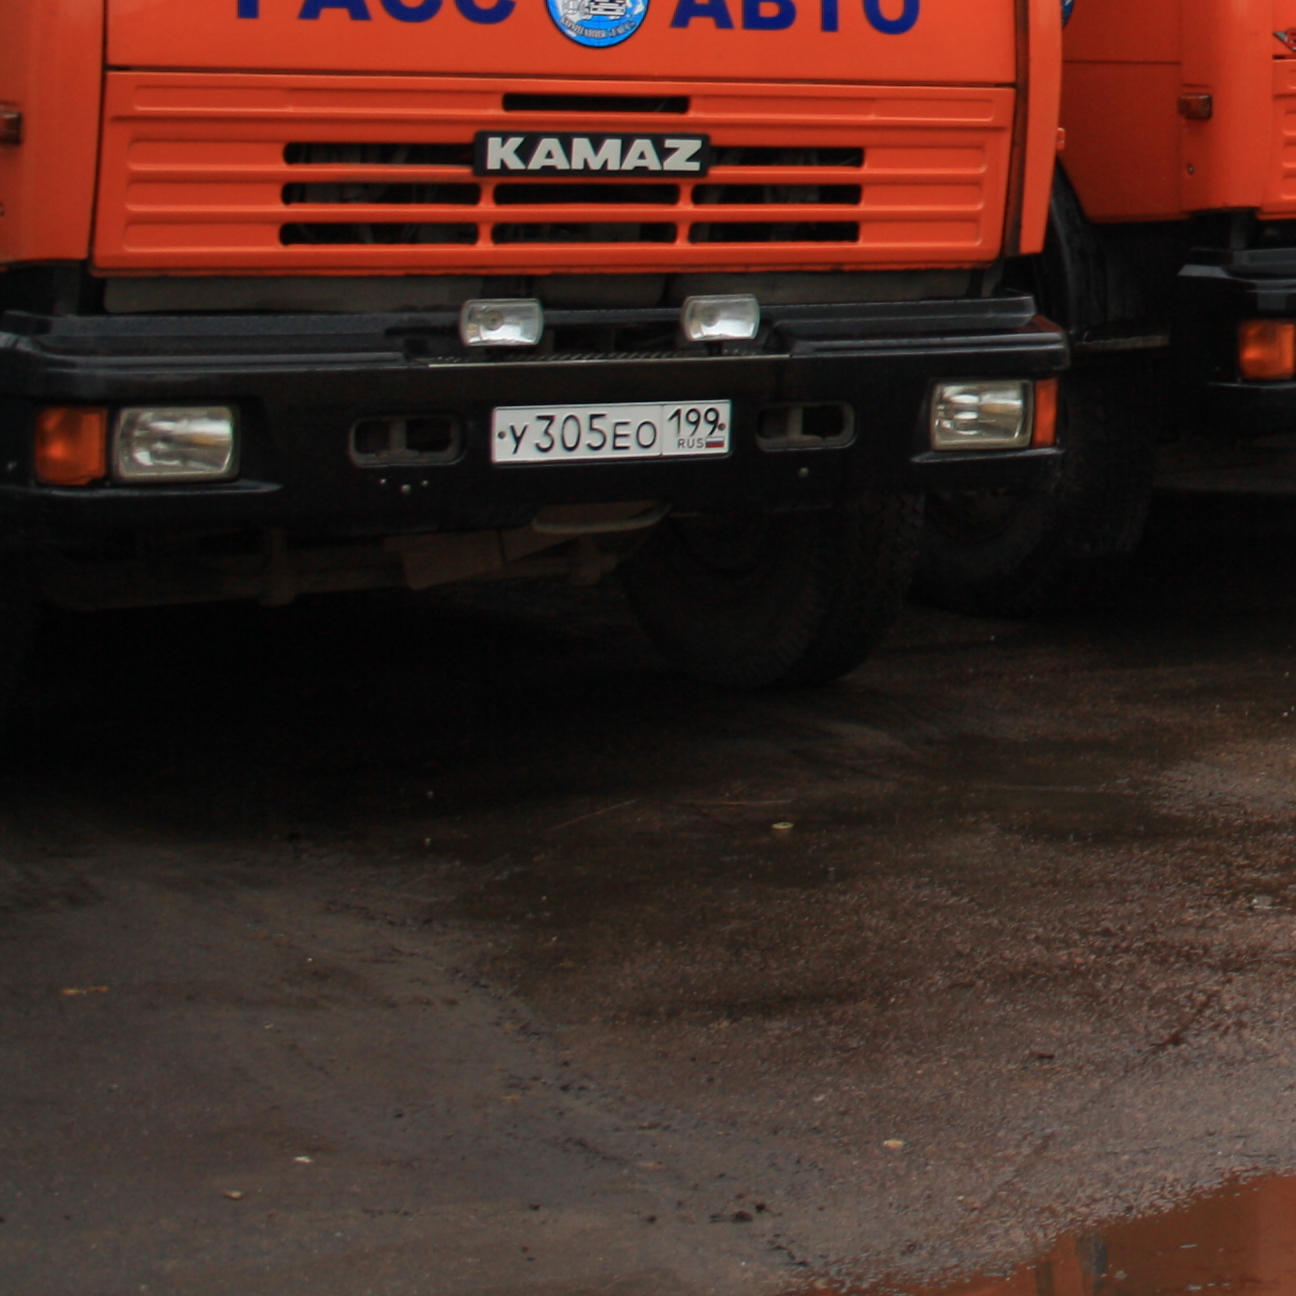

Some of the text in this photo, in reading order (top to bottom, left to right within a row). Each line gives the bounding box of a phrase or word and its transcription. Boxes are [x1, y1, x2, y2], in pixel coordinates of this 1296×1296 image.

[486, 137, 702, 171] KAMAZ
[509, 407, 720, 454] У305ЕО 199
[677, 438, 705, 449] RUS
